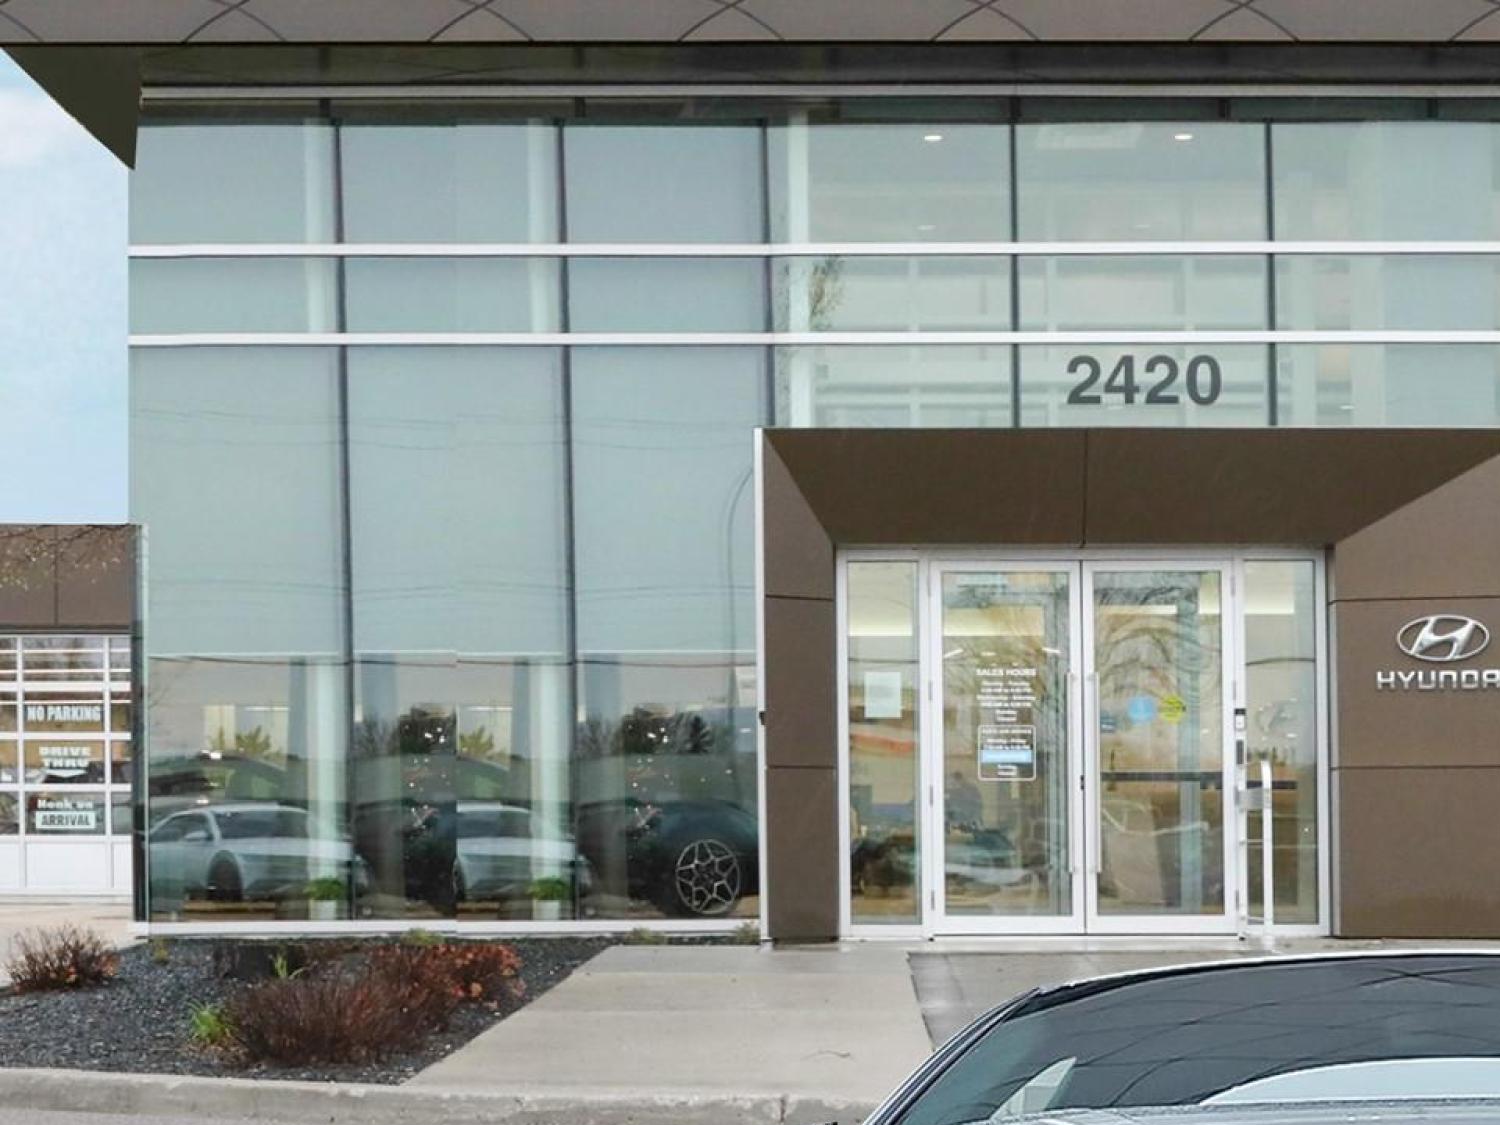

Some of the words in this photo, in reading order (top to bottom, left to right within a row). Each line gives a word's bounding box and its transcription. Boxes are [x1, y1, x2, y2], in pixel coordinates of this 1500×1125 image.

[1066, 354, 1223, 406] 2420
[27, 705, 45, 721] NO
[47, 705, 101, 721] PARKING
[41, 813, 91, 826] ARRIVAL
